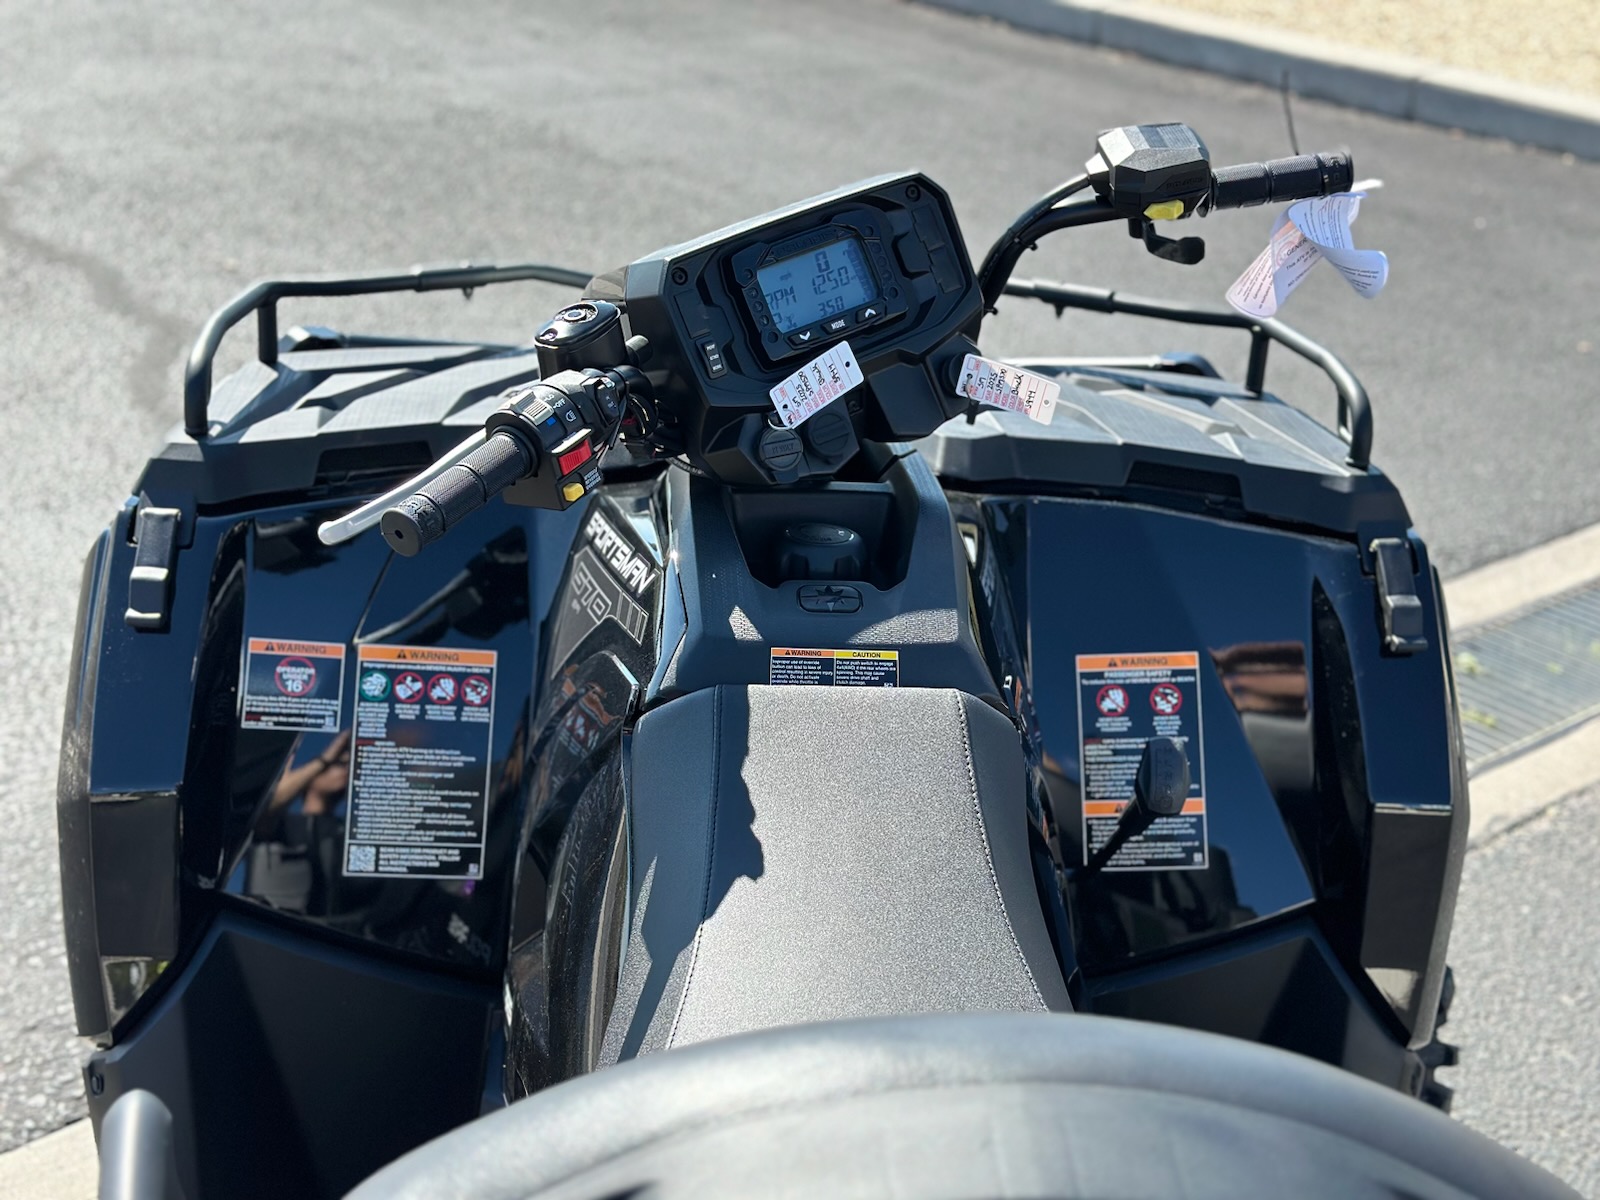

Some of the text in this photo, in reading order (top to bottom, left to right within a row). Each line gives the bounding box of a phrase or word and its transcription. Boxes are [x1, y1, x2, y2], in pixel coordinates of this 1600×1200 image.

[813, 250, 831, 273] 0
[810, 266, 852, 295] 1250
[817, 296, 847, 318] 350
[831, 319, 846, 330] MODE
[986, 372, 998, 390] 2025
[1010, 372, 1024, 396] Black
[795, 383, 809, 402] 2025
[584, 510, 656, 594] SPORTSMAN
[572, 562, 612, 623] 570
[277, 643, 326, 654] WARNING
[410, 651, 459, 661] WARNING
[276, 666, 316, 675] OPERATOR
[1120, 657, 1168, 666] WARNING
[285, 680, 303, 692] 16
